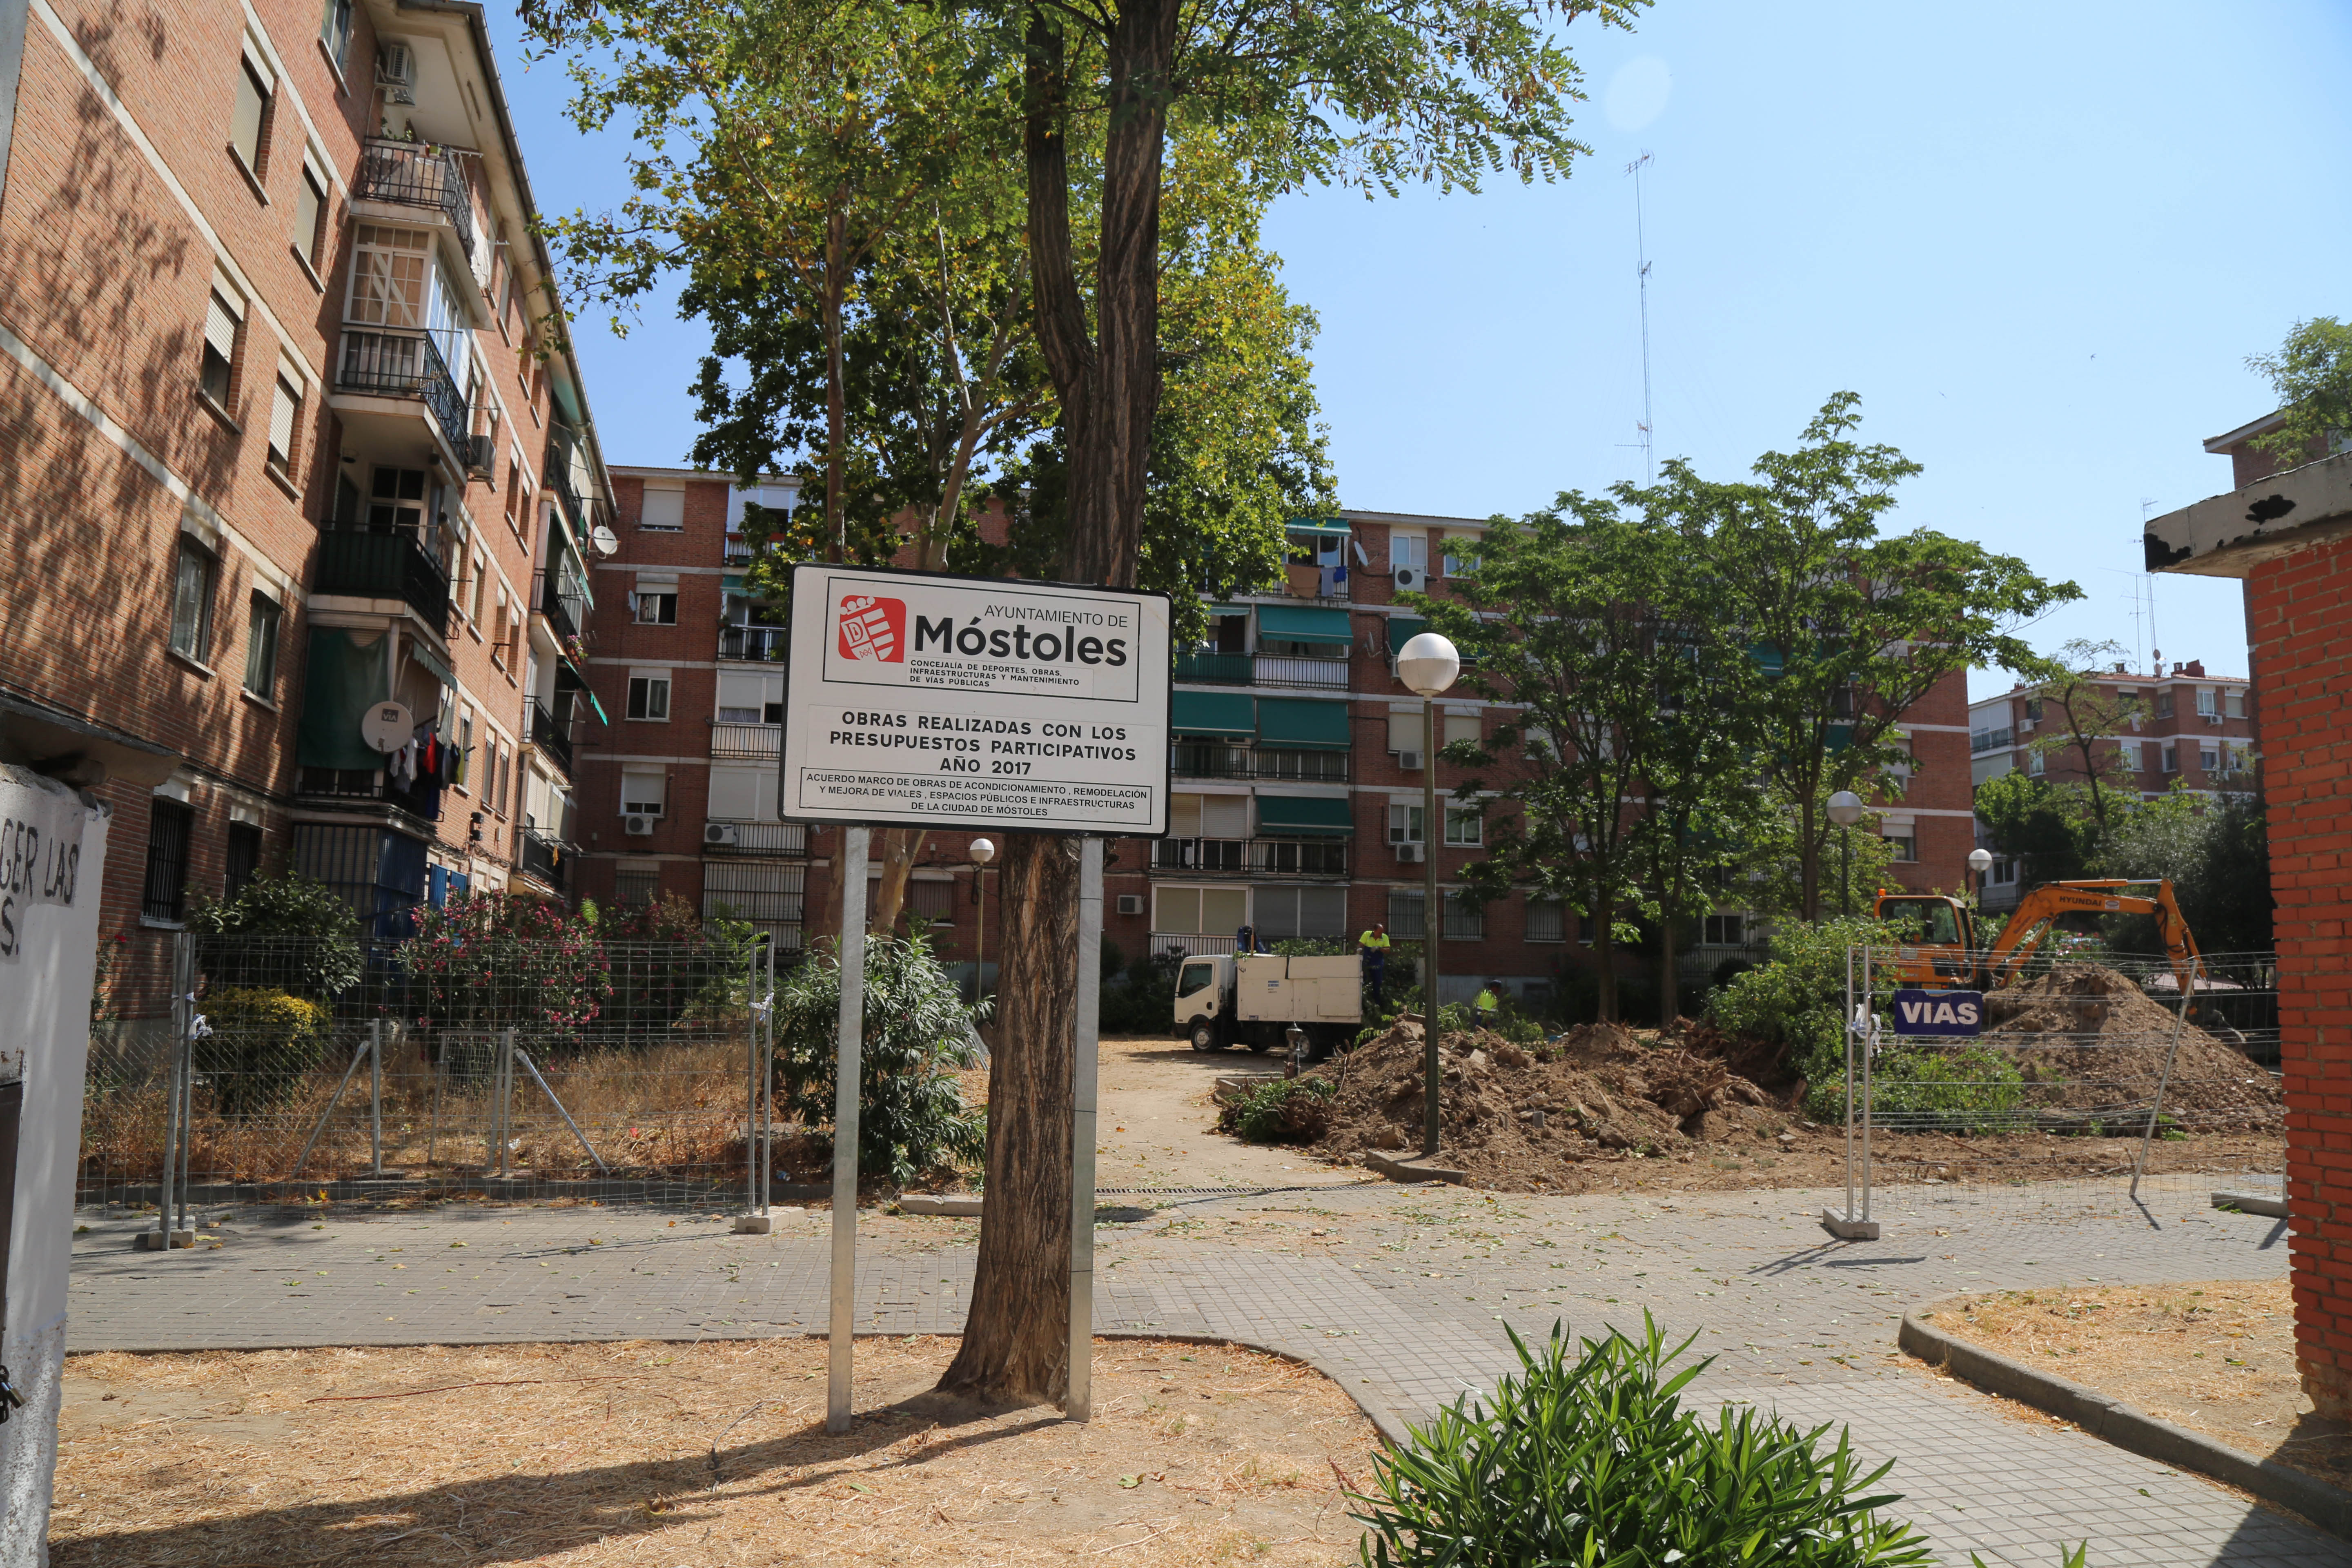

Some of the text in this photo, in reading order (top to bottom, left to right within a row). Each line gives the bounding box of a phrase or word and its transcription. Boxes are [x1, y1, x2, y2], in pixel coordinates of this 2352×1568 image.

[984, 605, 1128, 628] AYUNTAMIENTO DE
[914, 615, 1127, 667] Móstoles
[910, 659, 962, 669] CONCEJALÍA
[910, 667, 996, 679] INFRAESTRUCTURAS
[1010, 675, 1079, 686] MANTENIMIENTO
[925, 676, 944, 684] VÍAS
[949, 677, 990, 687] PÚBLICAS
[842, 711, 1126, 741] OBRAS REALIZADAS CON LOS
[830, 731, 1136, 761] PRESUPUESTOS PARTICIPATIVOS
[940, 756, 1031, 775] AÑO 2017
[806, 773, 855, 783] ACUERDO
[858, 776, 894, 785] MARCO
[897, 778, 910, 786] DE
[912, 779, 947, 788] OBRAS
[949, 780, 962, 789] DE
[964, 782, 1066, 794] ACONDICIONAMIENTO
[1074, 787, 1147, 799] REMODELACIÓN
[828, 786, 869, 796] MEJORA
[872, 788, 885, 796] DE
[887, 789, 922, 798] VIALES
[930, 791, 978, 801] ESPACIOS
[980, 794, 1028, 804] PÚBLICOS
[1039, 797, 1135, 809] INFRAESTRUCTURAS
[911, 802, 1048, 816] DE LA CIUDAD DE MÓSTOLES
[44, 837, 79, 904] LAS
[2059, 896, 2102, 907] HYUNDAI
[1900, 1002, 1978, 1025] VIAS
